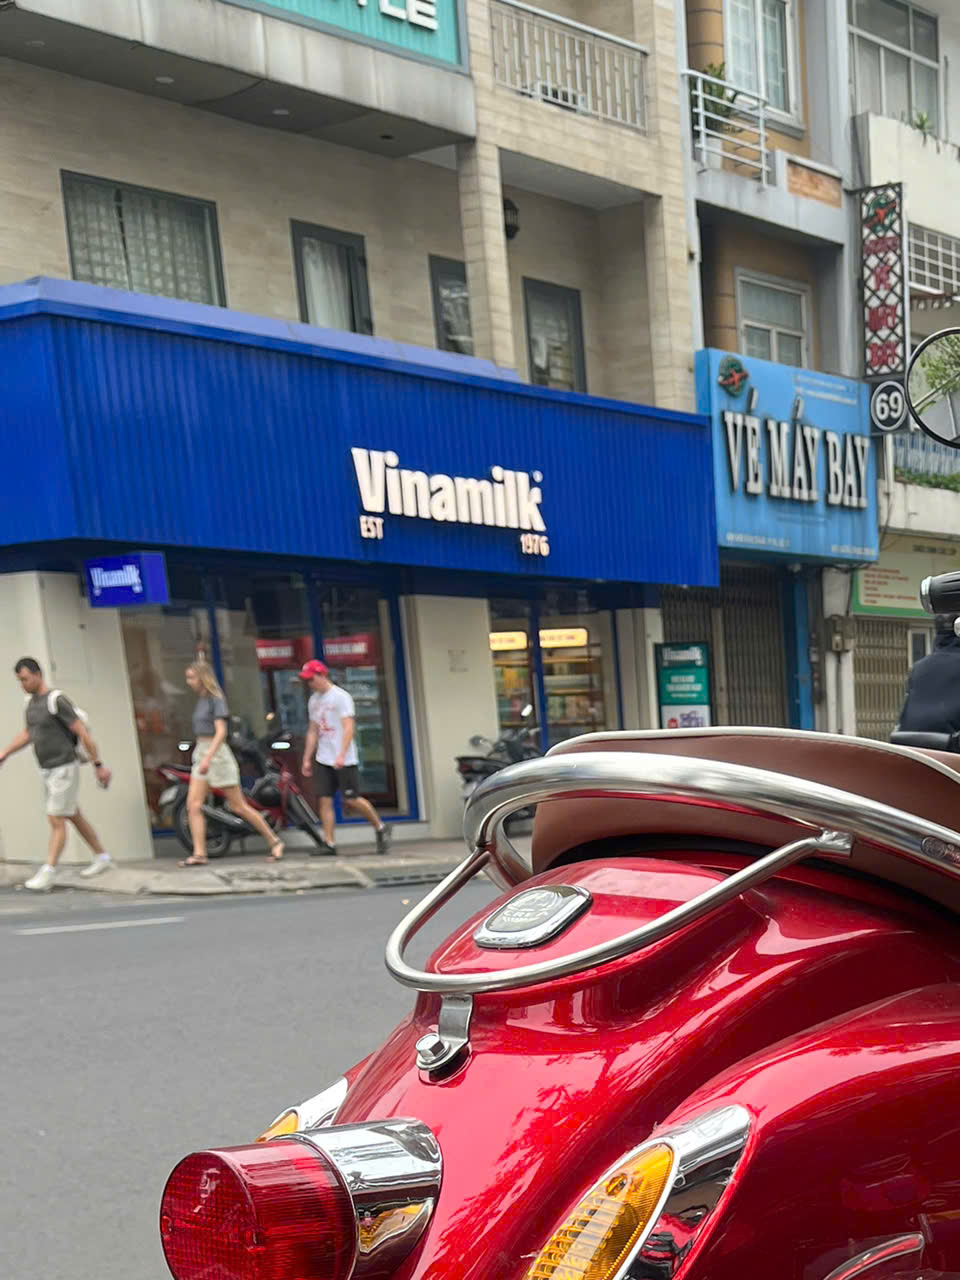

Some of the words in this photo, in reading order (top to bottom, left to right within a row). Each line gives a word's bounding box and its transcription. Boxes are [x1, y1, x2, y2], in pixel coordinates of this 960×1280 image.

[875, 391, 904, 422] 69
[723, 386, 763, 495] VÉ
[765, 396, 819, 502] MÁY
[824, 431, 870, 509] BAY
[350, 447, 547, 532] Vinamilk
[360, 515, 384, 539] EST
[519, 533, 550, 557] 1976
